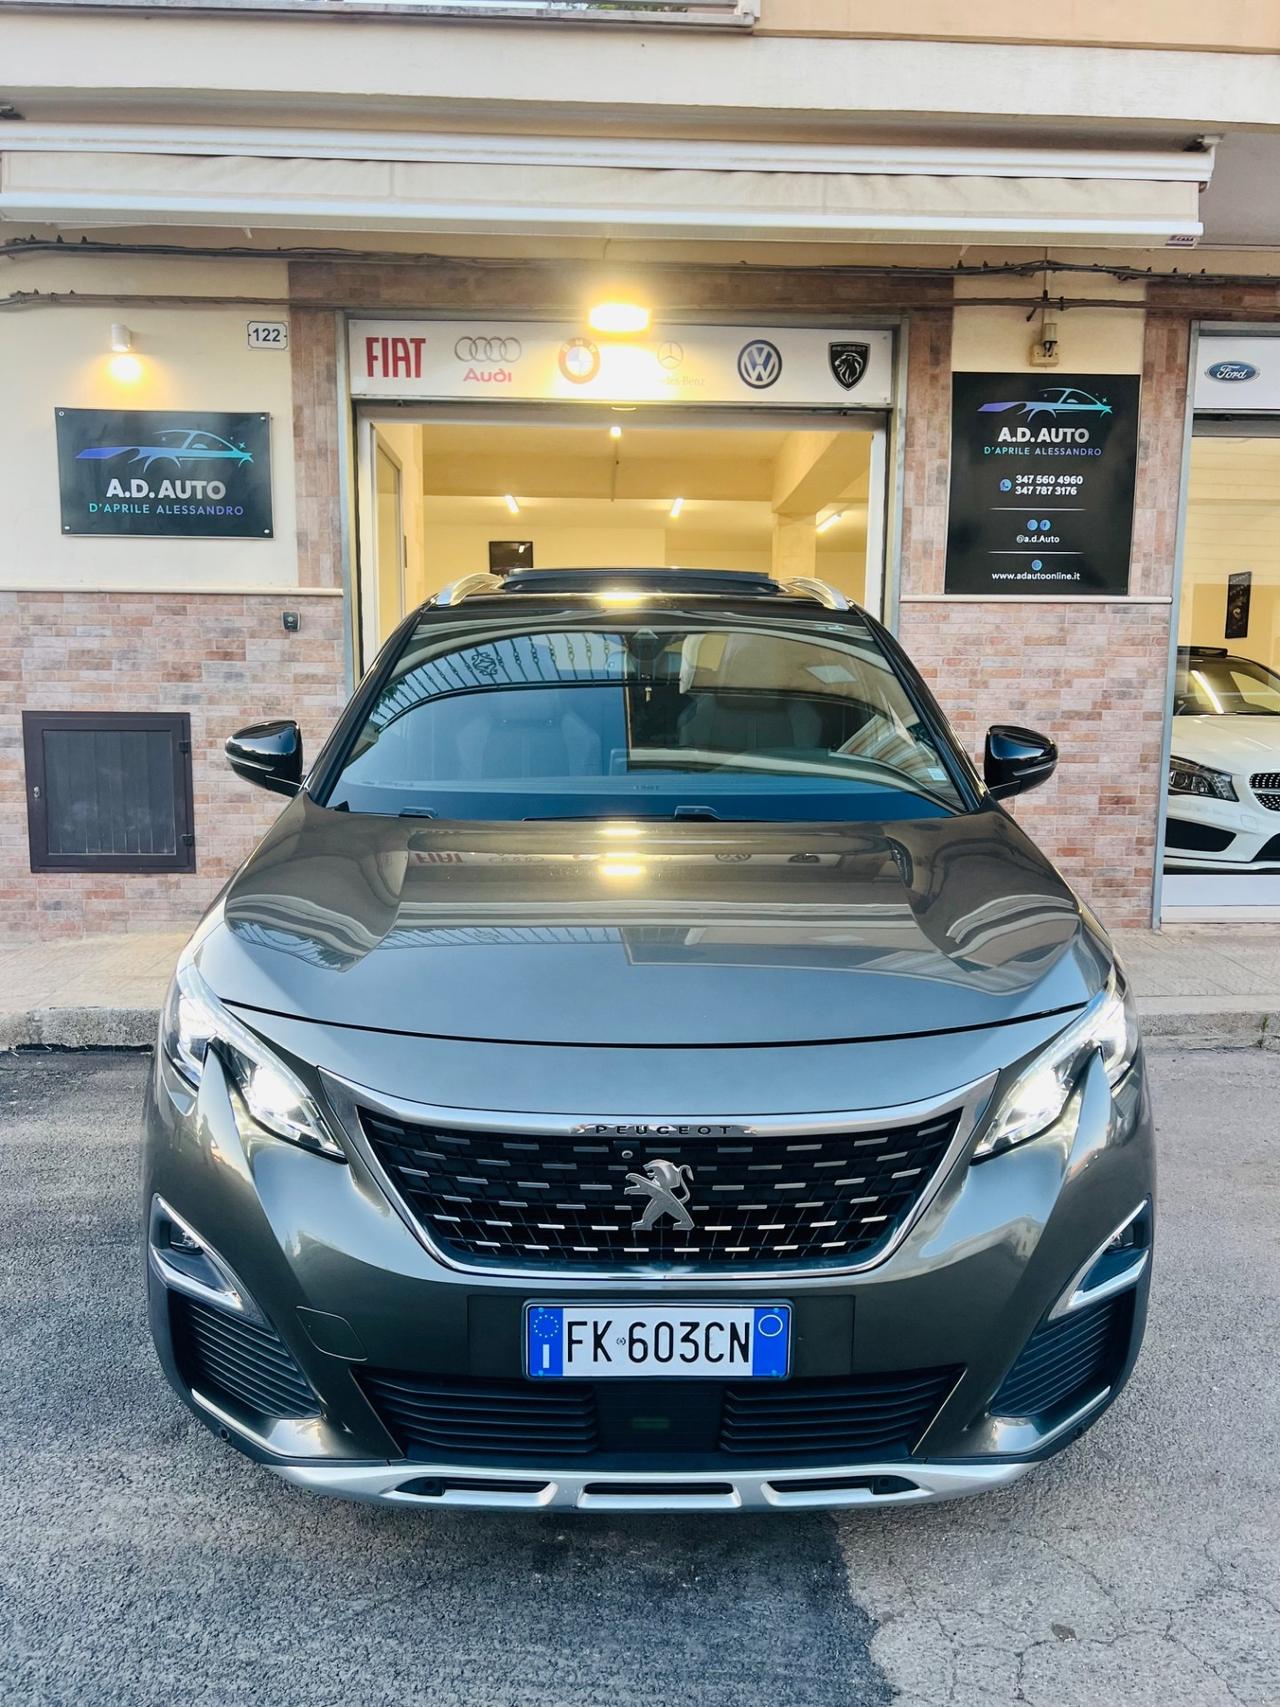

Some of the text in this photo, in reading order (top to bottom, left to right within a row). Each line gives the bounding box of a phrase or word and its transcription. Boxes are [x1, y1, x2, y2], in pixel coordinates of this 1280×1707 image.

[252, 328, 281, 342] 122
[365, 337, 426, 379] FIAT
[463, 368, 512, 383] Audi
[1216, 364, 1249, 379] Ford
[998, 427, 1090, 443] A.D. AUTO
[984, 446, 1102, 456] D'APRILE ALESSANDRO
[1015, 475, 1083, 485] 347 560 4960
[106, 478, 226, 500] A.D. AUTO
[1015, 486, 1077, 495] 347 787 3176
[89, 503, 244, 516] D'APRILE ALESSANDRO
[991, 571, 1081, 580] www.adautoonline.it
[595, 1125, 732, 1135] PEUGEOT
